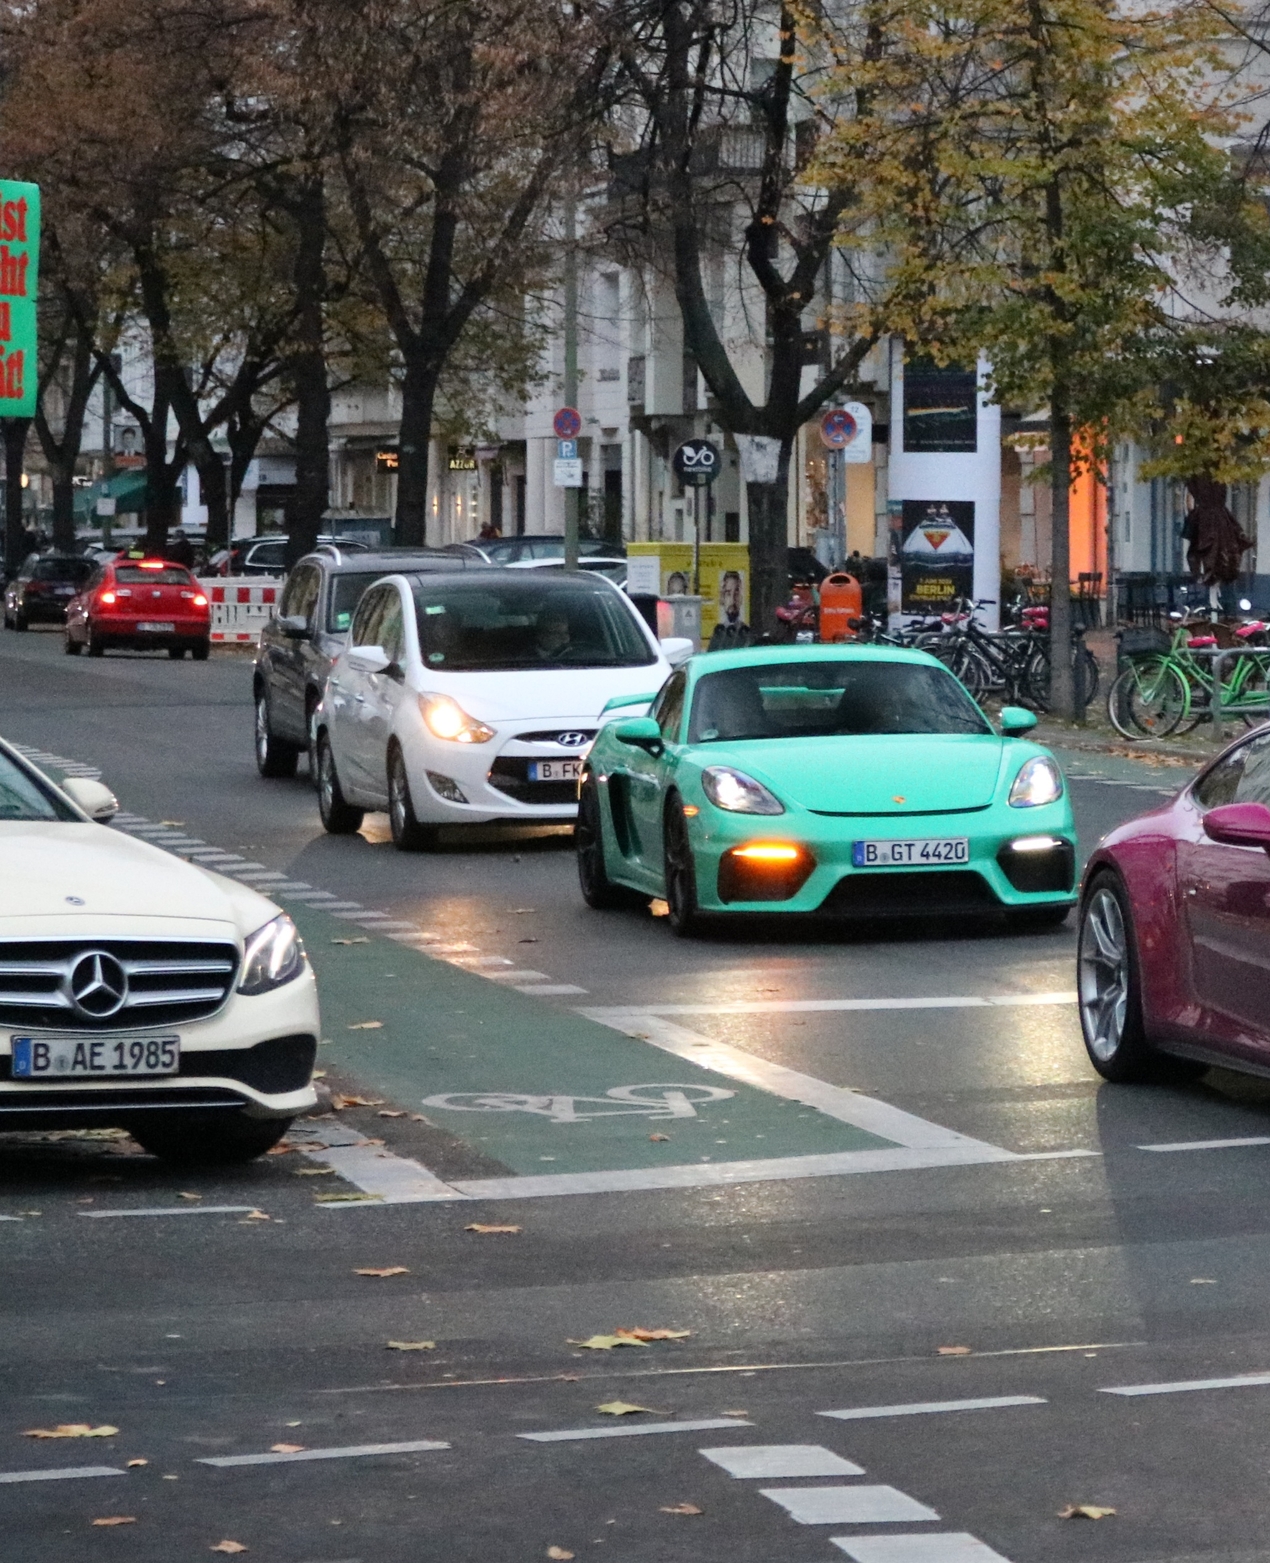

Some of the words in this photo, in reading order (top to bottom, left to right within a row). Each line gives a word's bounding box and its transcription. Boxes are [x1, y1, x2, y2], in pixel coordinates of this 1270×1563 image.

[0, 196, 27, 243] st
[916, 584, 955, 595] BERLIN
[542, 764, 552, 778] B
[866, 844, 878, 862] B
[891, 843, 915, 861] GT
[920, 842, 965, 861] 4420
[33, 1043, 50, 1071] B
[71, 1043, 106, 1071] AE
[112, 1041, 178, 1071] 1985
